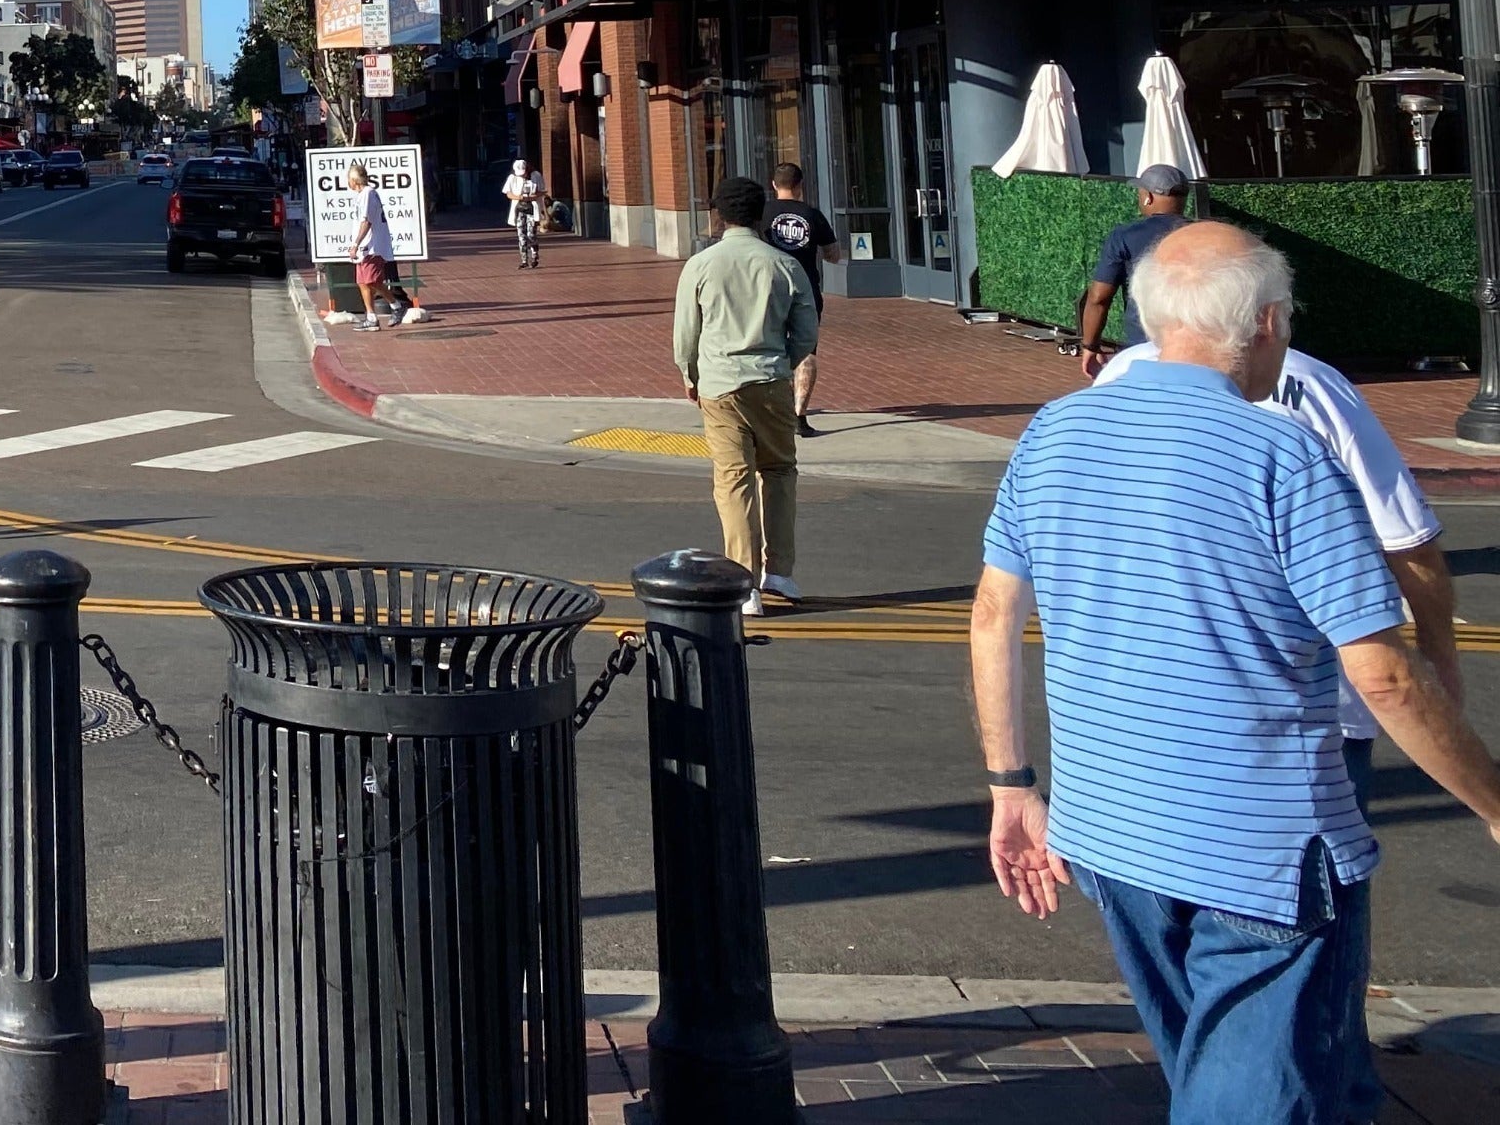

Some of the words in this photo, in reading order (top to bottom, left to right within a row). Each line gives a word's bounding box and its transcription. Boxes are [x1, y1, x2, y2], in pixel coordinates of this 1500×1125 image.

[365, 57, 376, 67] NO
[366, 69, 391, 78] PARKING
[318, 159, 346, 171] 5TH
[350, 156, 409, 169] AVENUE
[317, 173, 412, 192] CLSED
[326, 198, 335, 208] K
[321, 211, 347, 221] WED
[396, 209, 414, 219] AM
[324, 234, 346, 244] THU
[396, 232, 414, 242] AM
[855, 236, 868, 250] A
[935, 234, 946, 248] A
